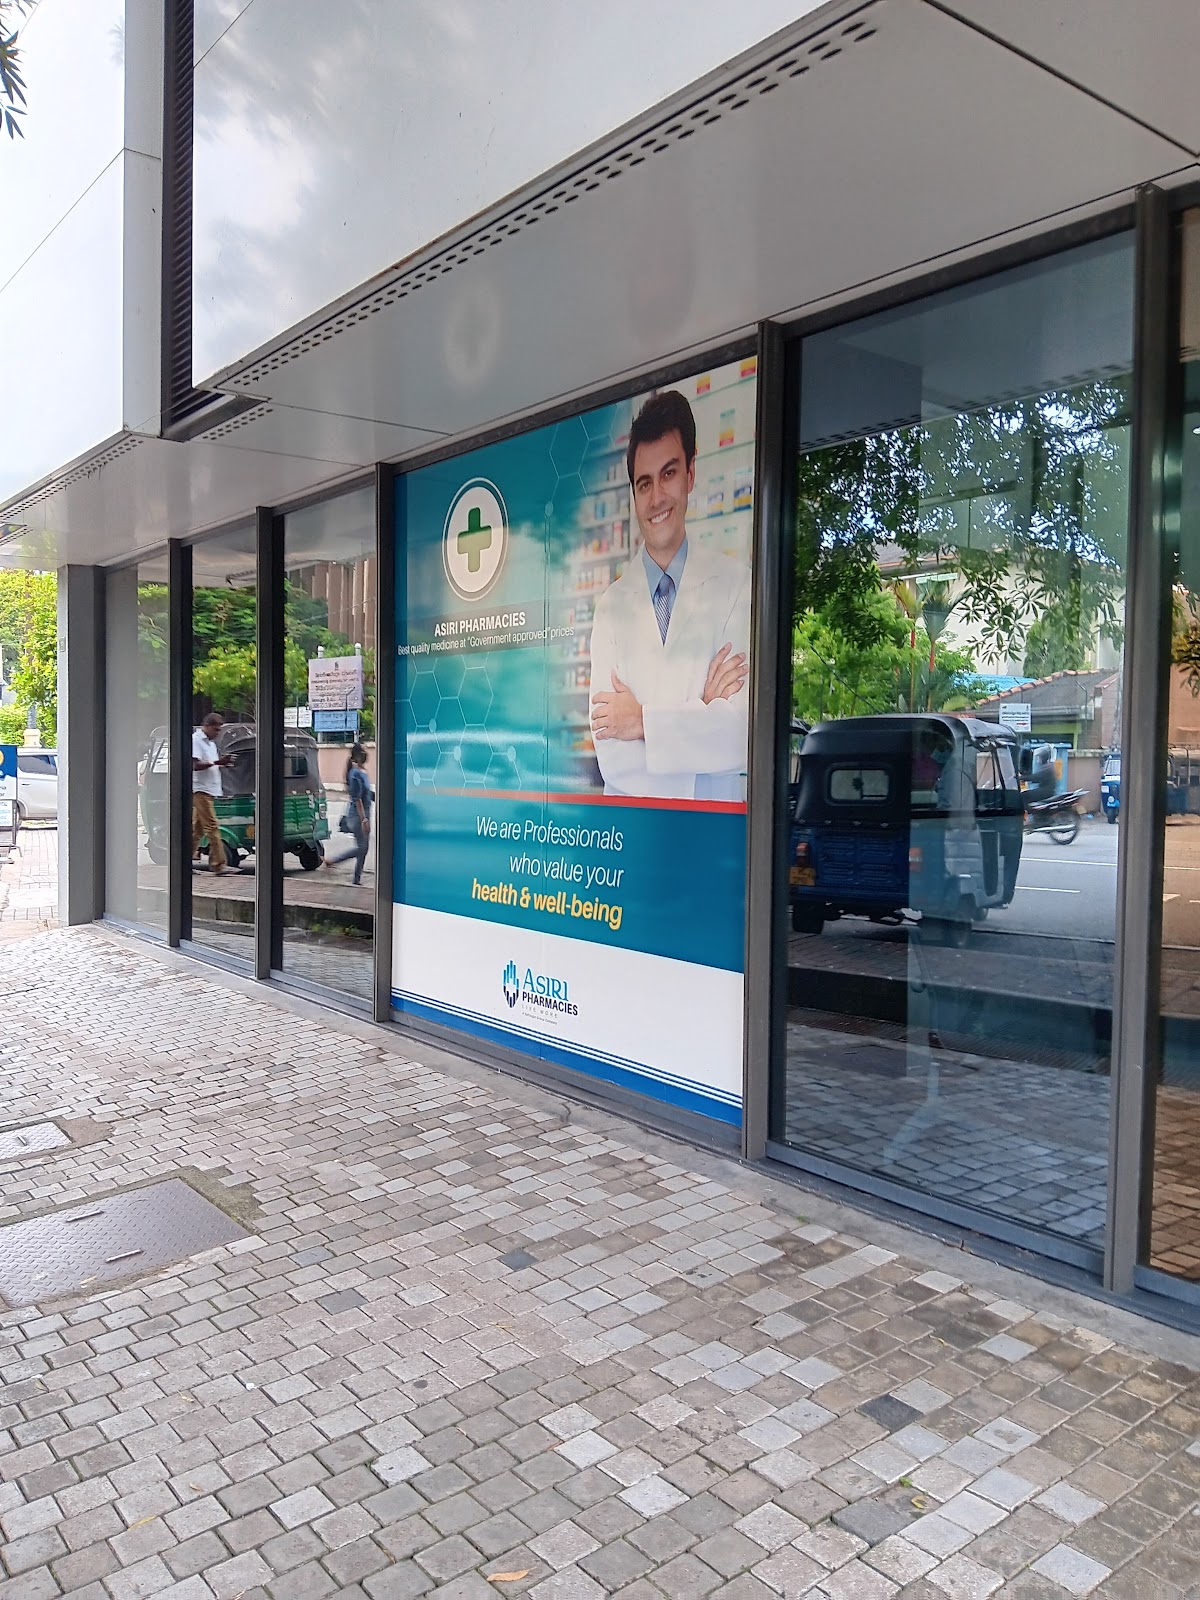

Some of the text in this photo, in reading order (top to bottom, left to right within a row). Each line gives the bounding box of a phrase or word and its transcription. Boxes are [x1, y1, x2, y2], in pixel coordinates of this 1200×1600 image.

[397, 644, 410, 656] Best
[410, 641, 431, 656] quality
[431, 639, 459, 651] medicine
[459, 637, 467, 648] at
[551, 625, 575, 640] prices
[434, 611, 526, 637] ASIRI PHARMACIES
[476, 815, 624, 851] We are Professionals
[509, 851, 625, 889] who value your
[471, 877, 623, 931] health & well-being
[522, 991, 578, 1016] PHARMACIES
